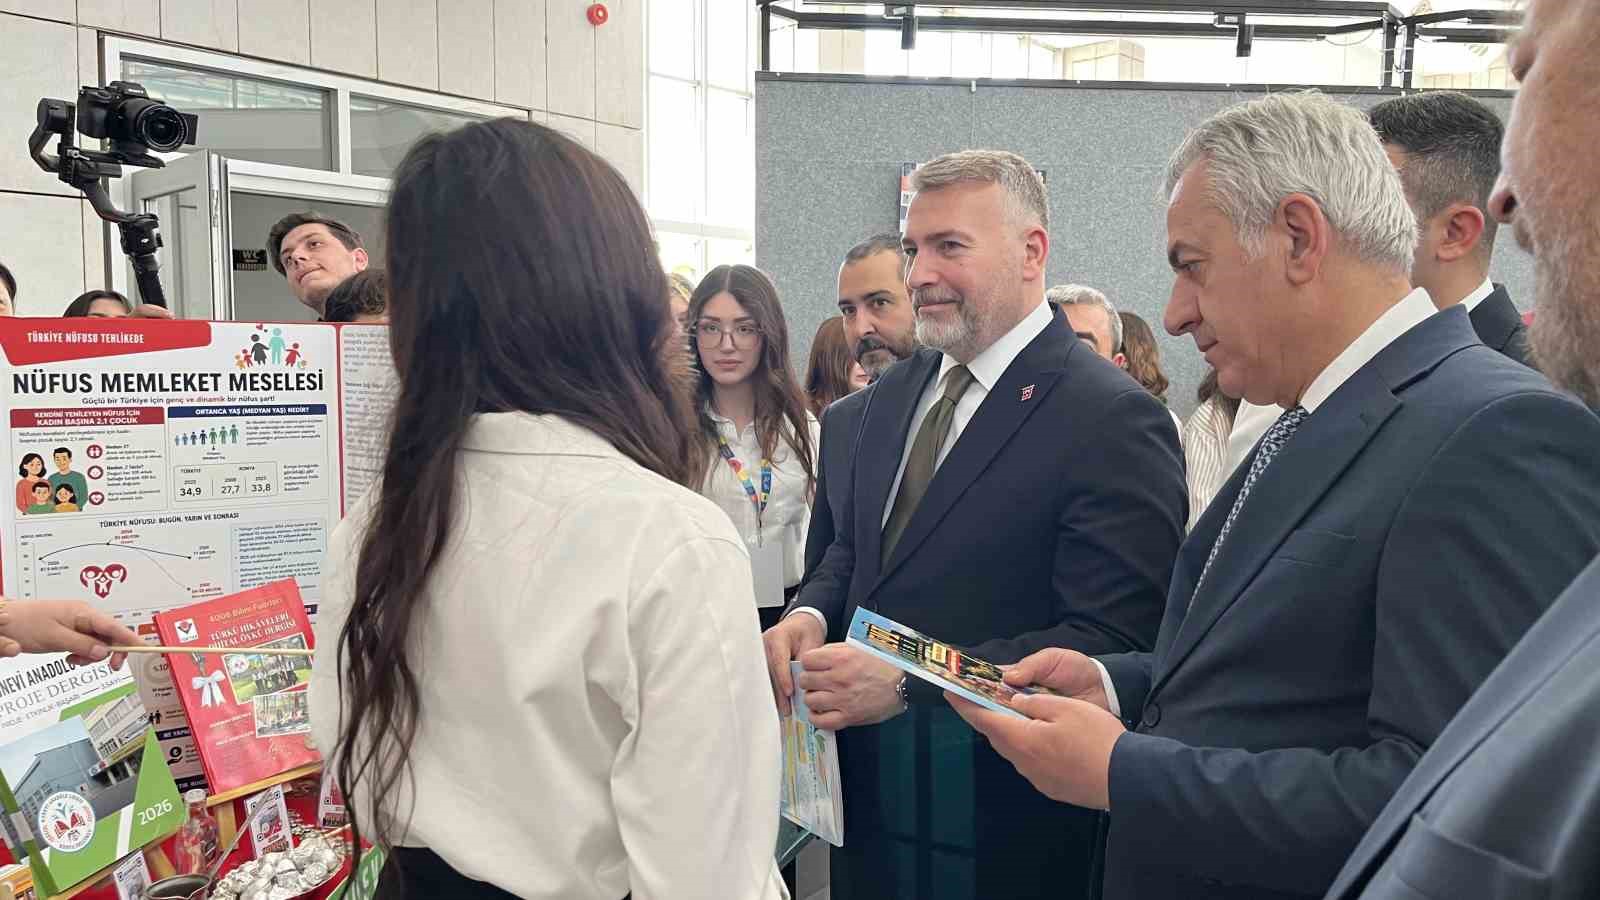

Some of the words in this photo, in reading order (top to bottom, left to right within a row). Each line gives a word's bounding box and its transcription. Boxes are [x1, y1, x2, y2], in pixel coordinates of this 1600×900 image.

[28, 330, 62, 343] TÜRKİYE
[65, 331, 98, 343] NÜFUSU
[101, 332, 144, 344] TEHLİKEDE
[13, 369, 93, 393] NÜFUS
[101, 372, 221, 393] MEMLEKET
[230, 369, 323, 392] MESELESİ
[82, 397, 105, 406] Güçlü
[108, 396, 116, 405] bir
[121, 396, 148, 406] Türkiye
[228, 408, 241, 416] YAŞ
[242, 407, 272, 415] (MEDYAN
[37, 418, 63, 426] KADIN
[110, 416, 138, 425] ÇOCUK
[180, 487, 201, 497] 34,9
[221, 485, 240, 494] 27,7
[251, 483, 271, 493] 33,8
[100, 518, 128, 528] TÜRKİYE
[185, 514, 202, 522] YARIN
[0, 670, 26, 697] NEVİ
[0, 688, 44, 717] ROJE
[137, 799, 173, 826] 2026
